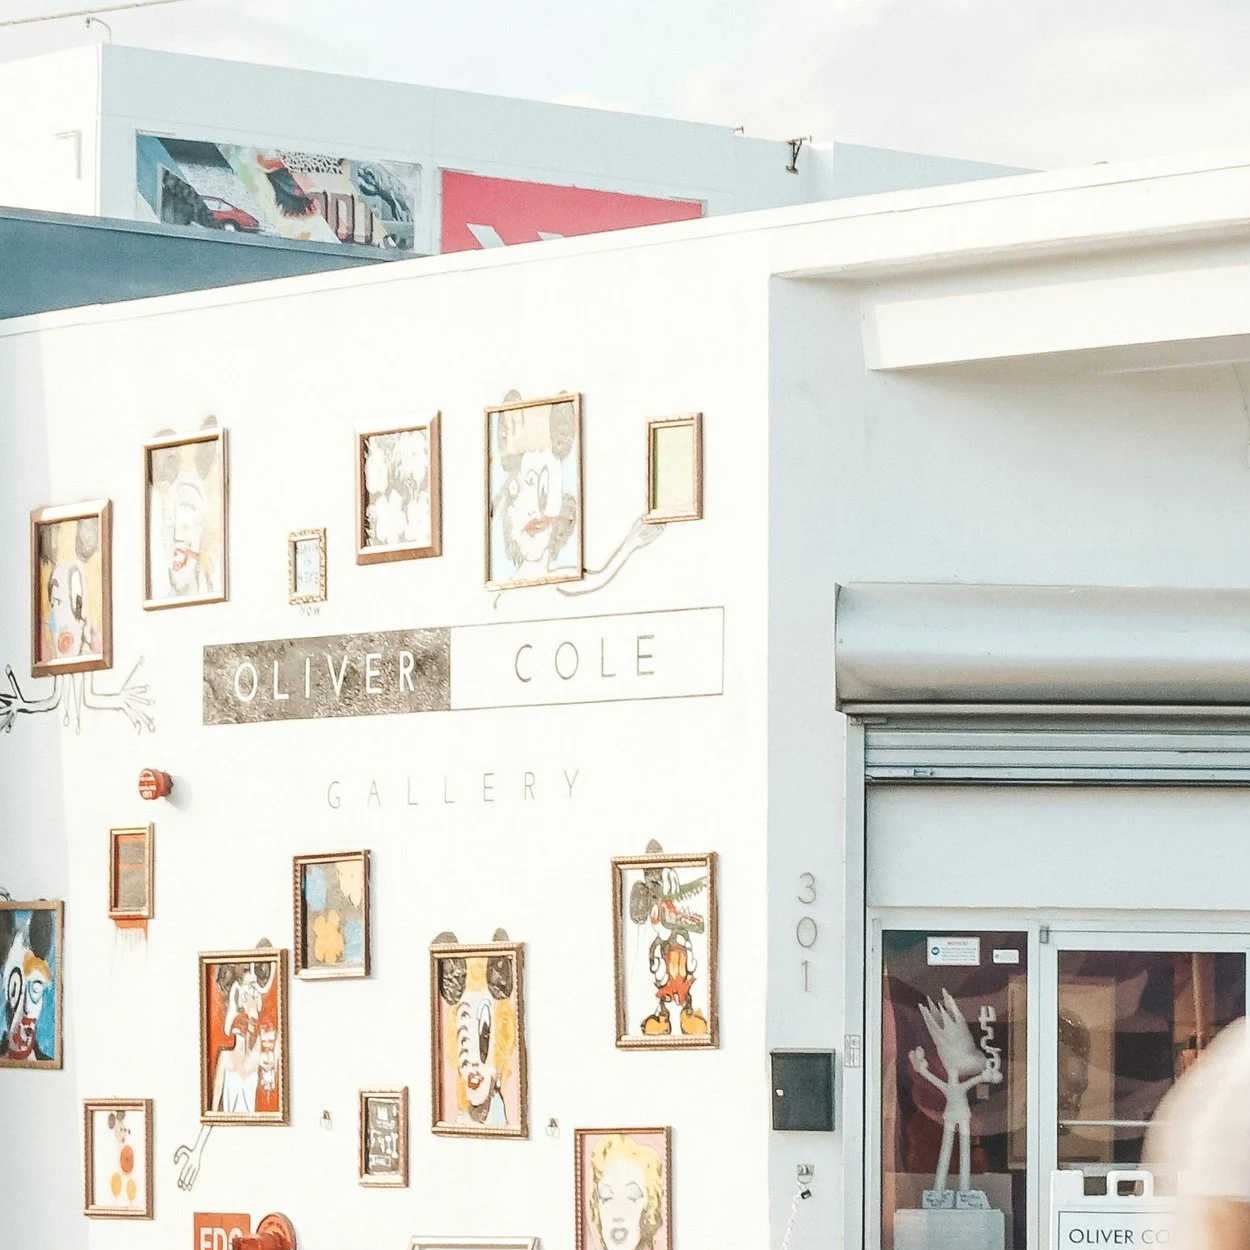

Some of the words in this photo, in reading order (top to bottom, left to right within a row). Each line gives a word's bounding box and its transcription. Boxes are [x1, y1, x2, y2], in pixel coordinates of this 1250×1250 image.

[234, 650, 415, 702] OLIVER
[515, 634, 655, 683] COLE
[327, 769, 579, 810] GALLERY
[796, 872, 818, 992] 301
[1069, 1229, 1134, 1244] OLIVER
[1141, 1229, 1171, 1244] CO
